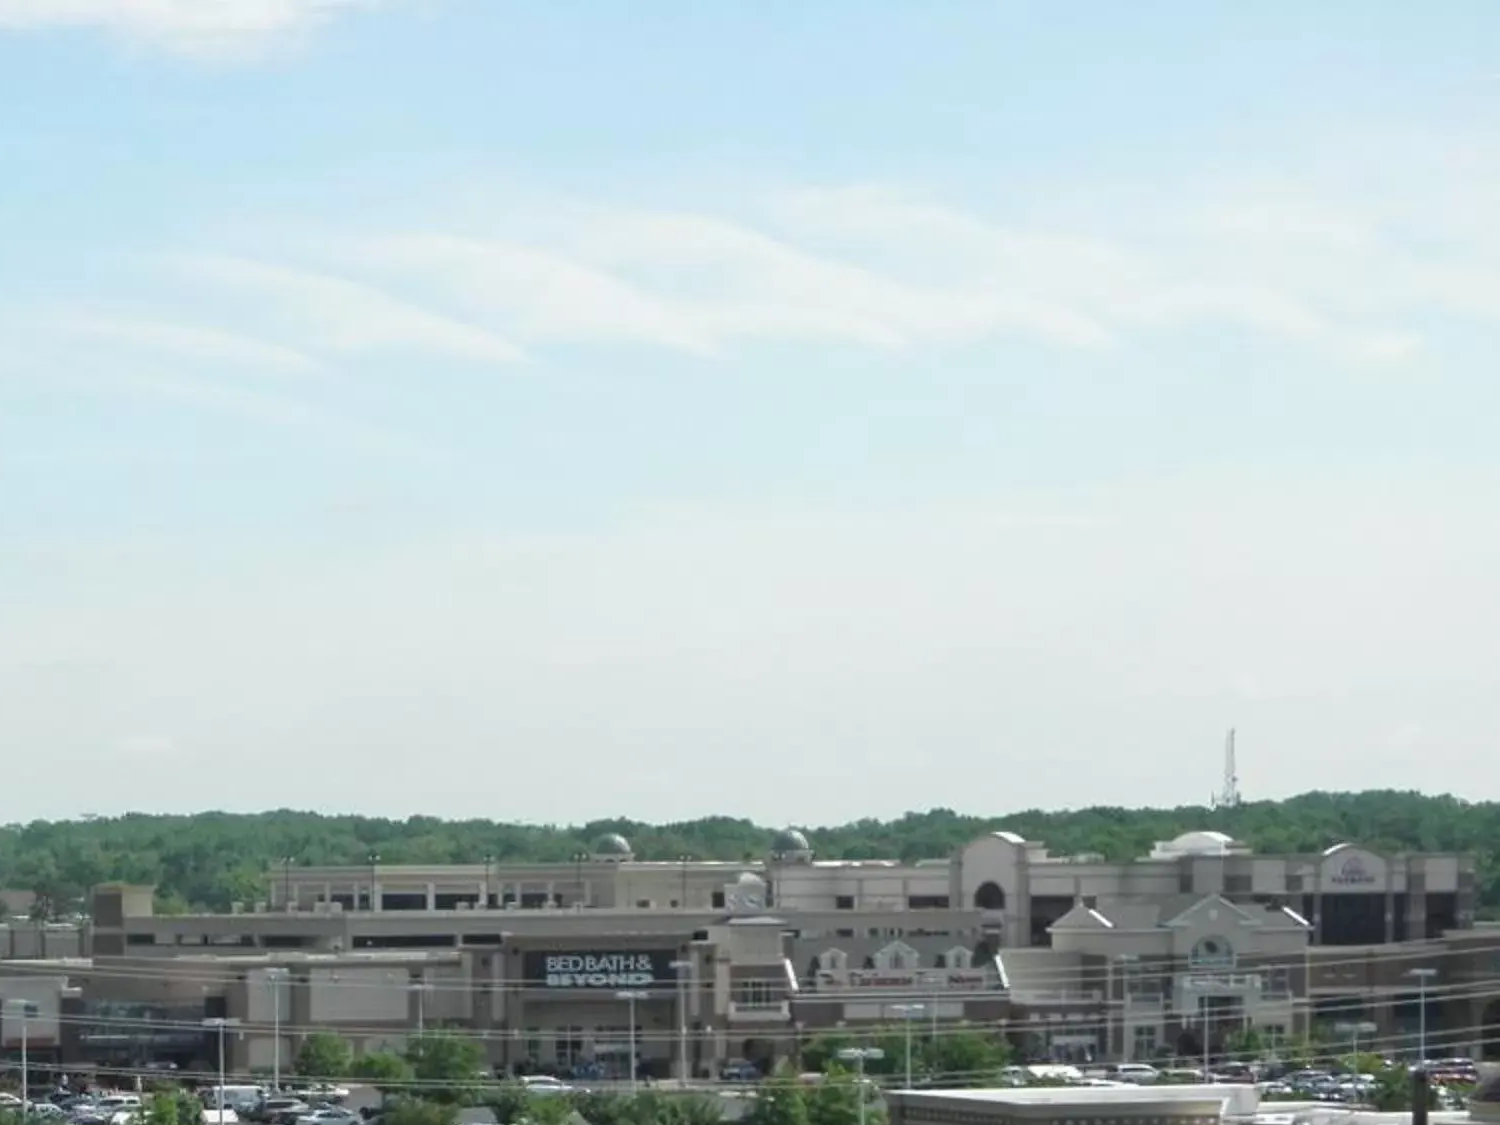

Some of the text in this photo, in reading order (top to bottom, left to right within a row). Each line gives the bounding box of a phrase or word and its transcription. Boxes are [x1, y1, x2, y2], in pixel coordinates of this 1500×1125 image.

[546, 954, 653, 971] BED BATH &
[546, 973, 654, 986] BEYOND
